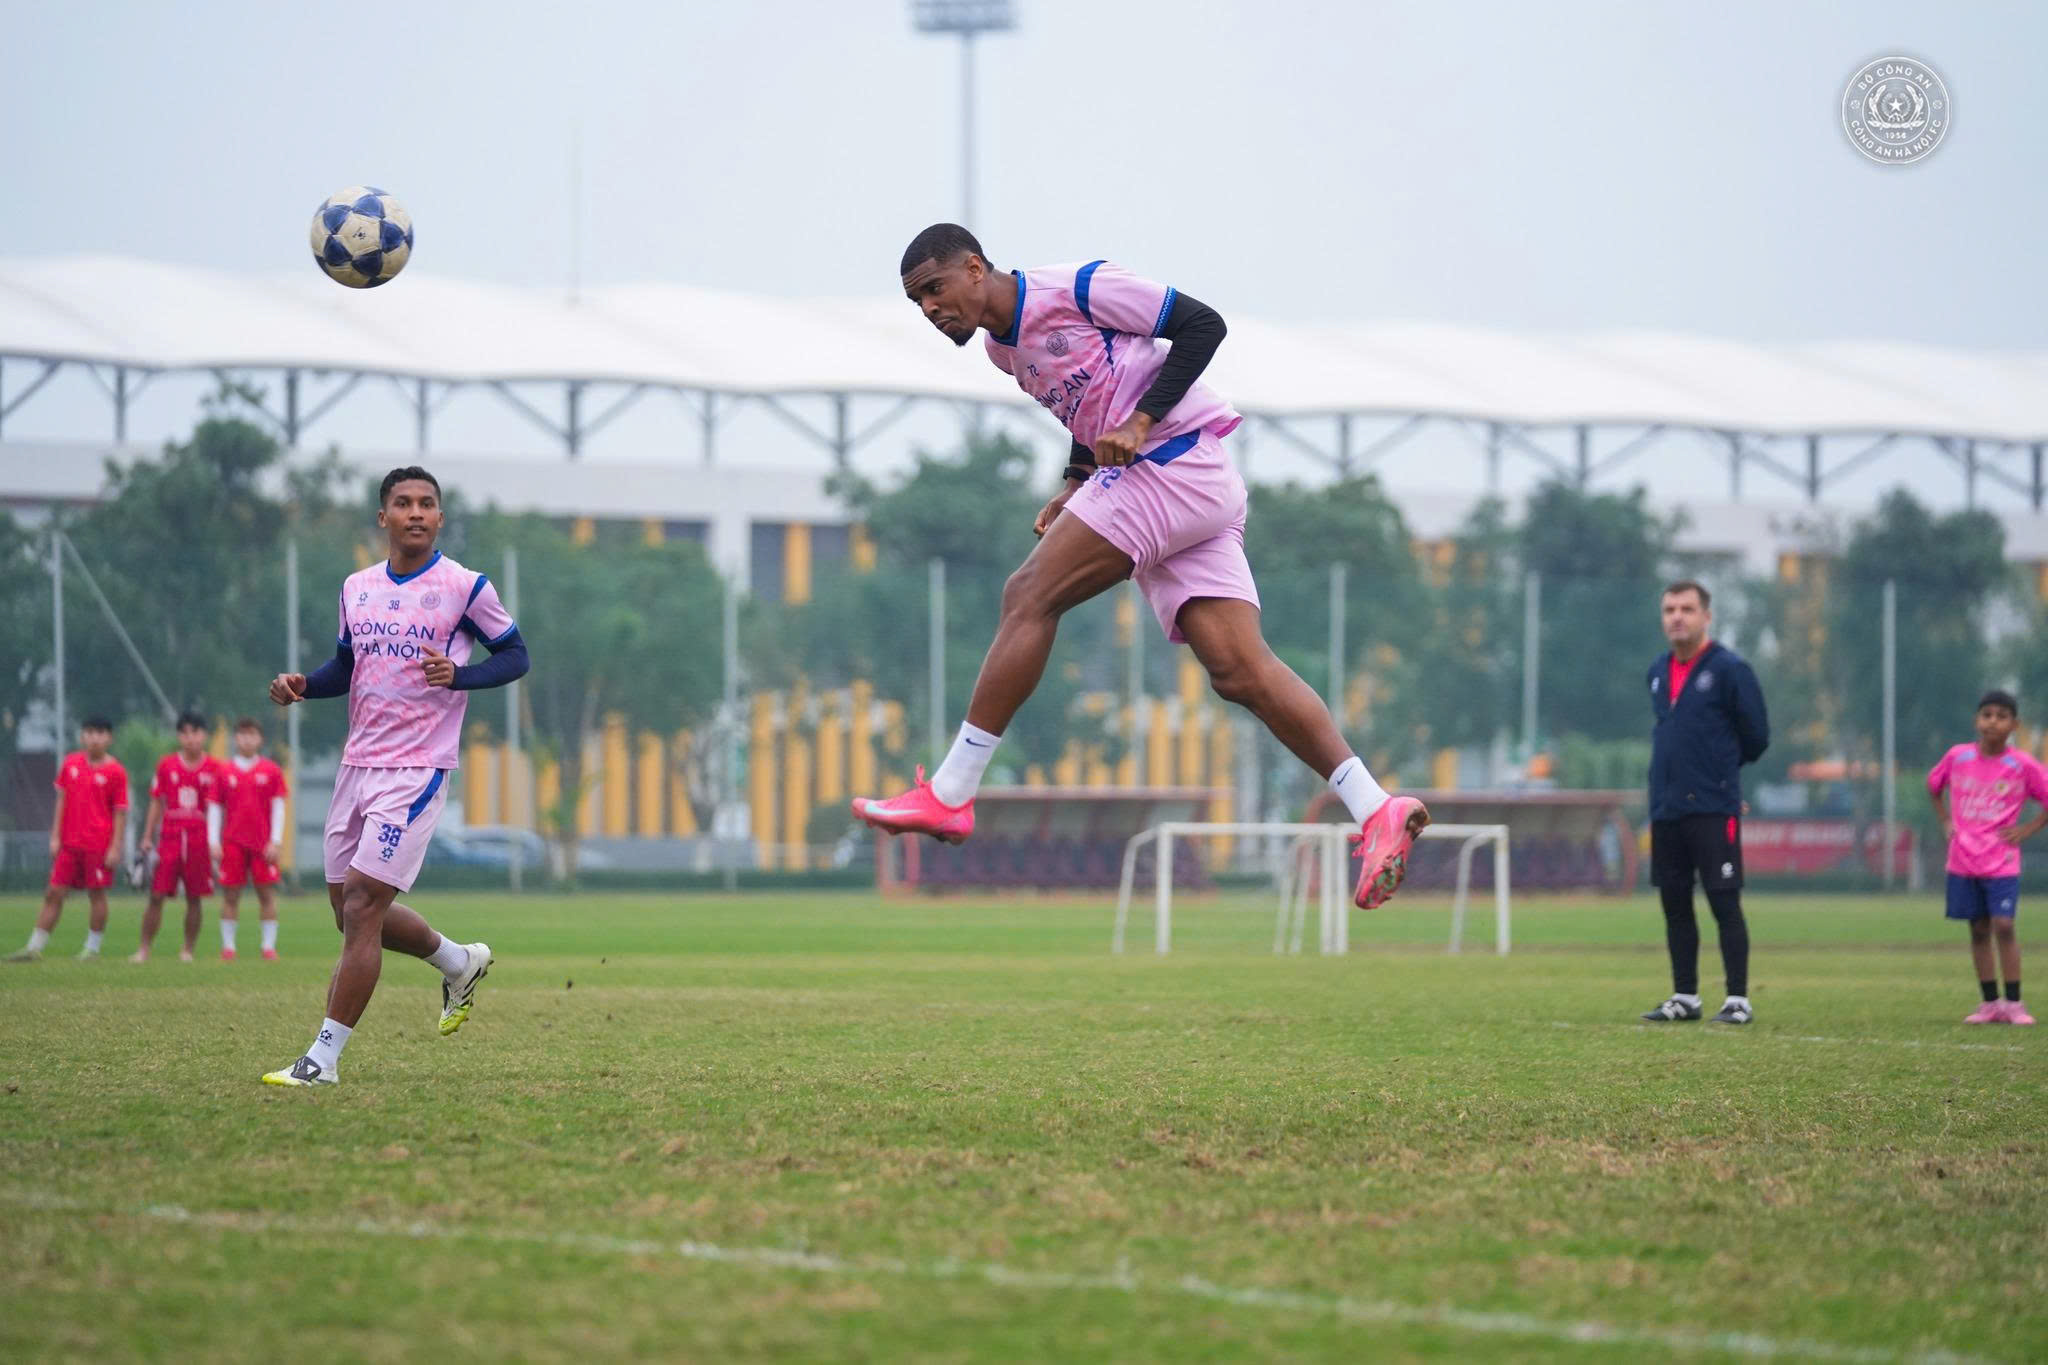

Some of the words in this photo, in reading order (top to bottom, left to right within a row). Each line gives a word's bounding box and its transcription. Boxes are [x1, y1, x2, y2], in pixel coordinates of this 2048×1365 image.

[1063, 368, 1092, 396] AN
[388, 600, 400, 610] 38
[352, 618, 400, 636] CÔNG
[405, 624, 435, 641] AN
[387, 641, 420, 661] NỘI
[378, 823, 402, 847] 38
